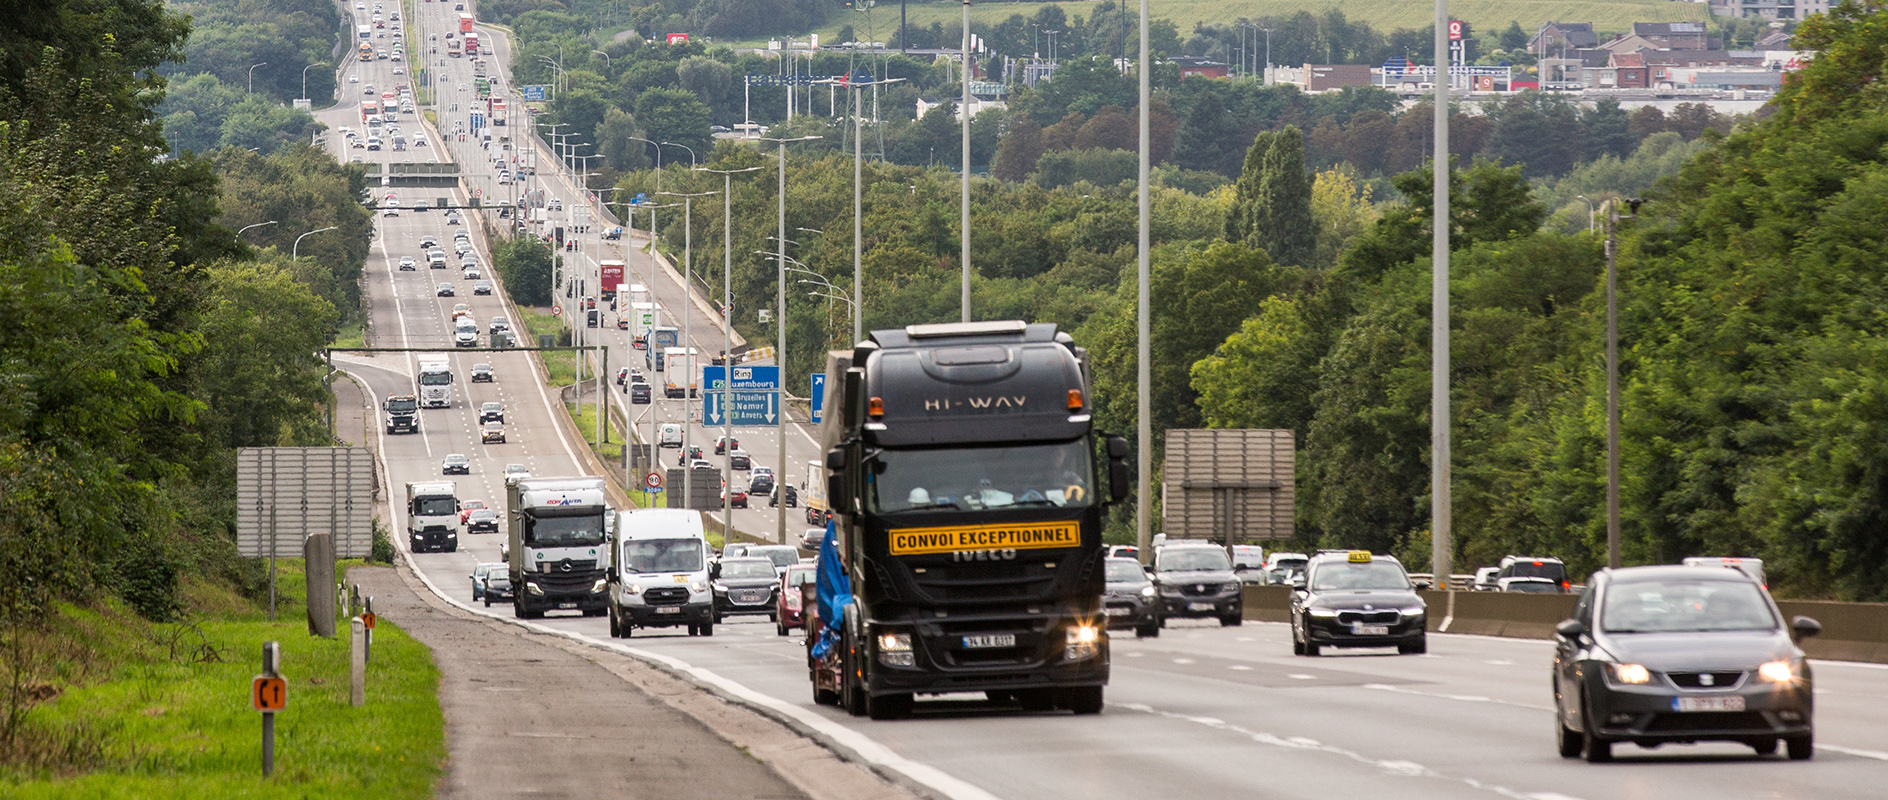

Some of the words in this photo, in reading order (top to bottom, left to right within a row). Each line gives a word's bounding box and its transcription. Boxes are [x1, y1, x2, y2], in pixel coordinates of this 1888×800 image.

[735, 370, 751, 378] Ring
[730, 380, 775, 389] uxembourg
[736, 402, 764, 410] Namur
[741, 411, 763, 419] Anvers
[649, 476, 659, 484] 90
[896, 533, 954, 549] CONVOI
[959, 527, 1073, 546] EXCEPTIONNEL
[953, 549, 1017, 562] IVECO
